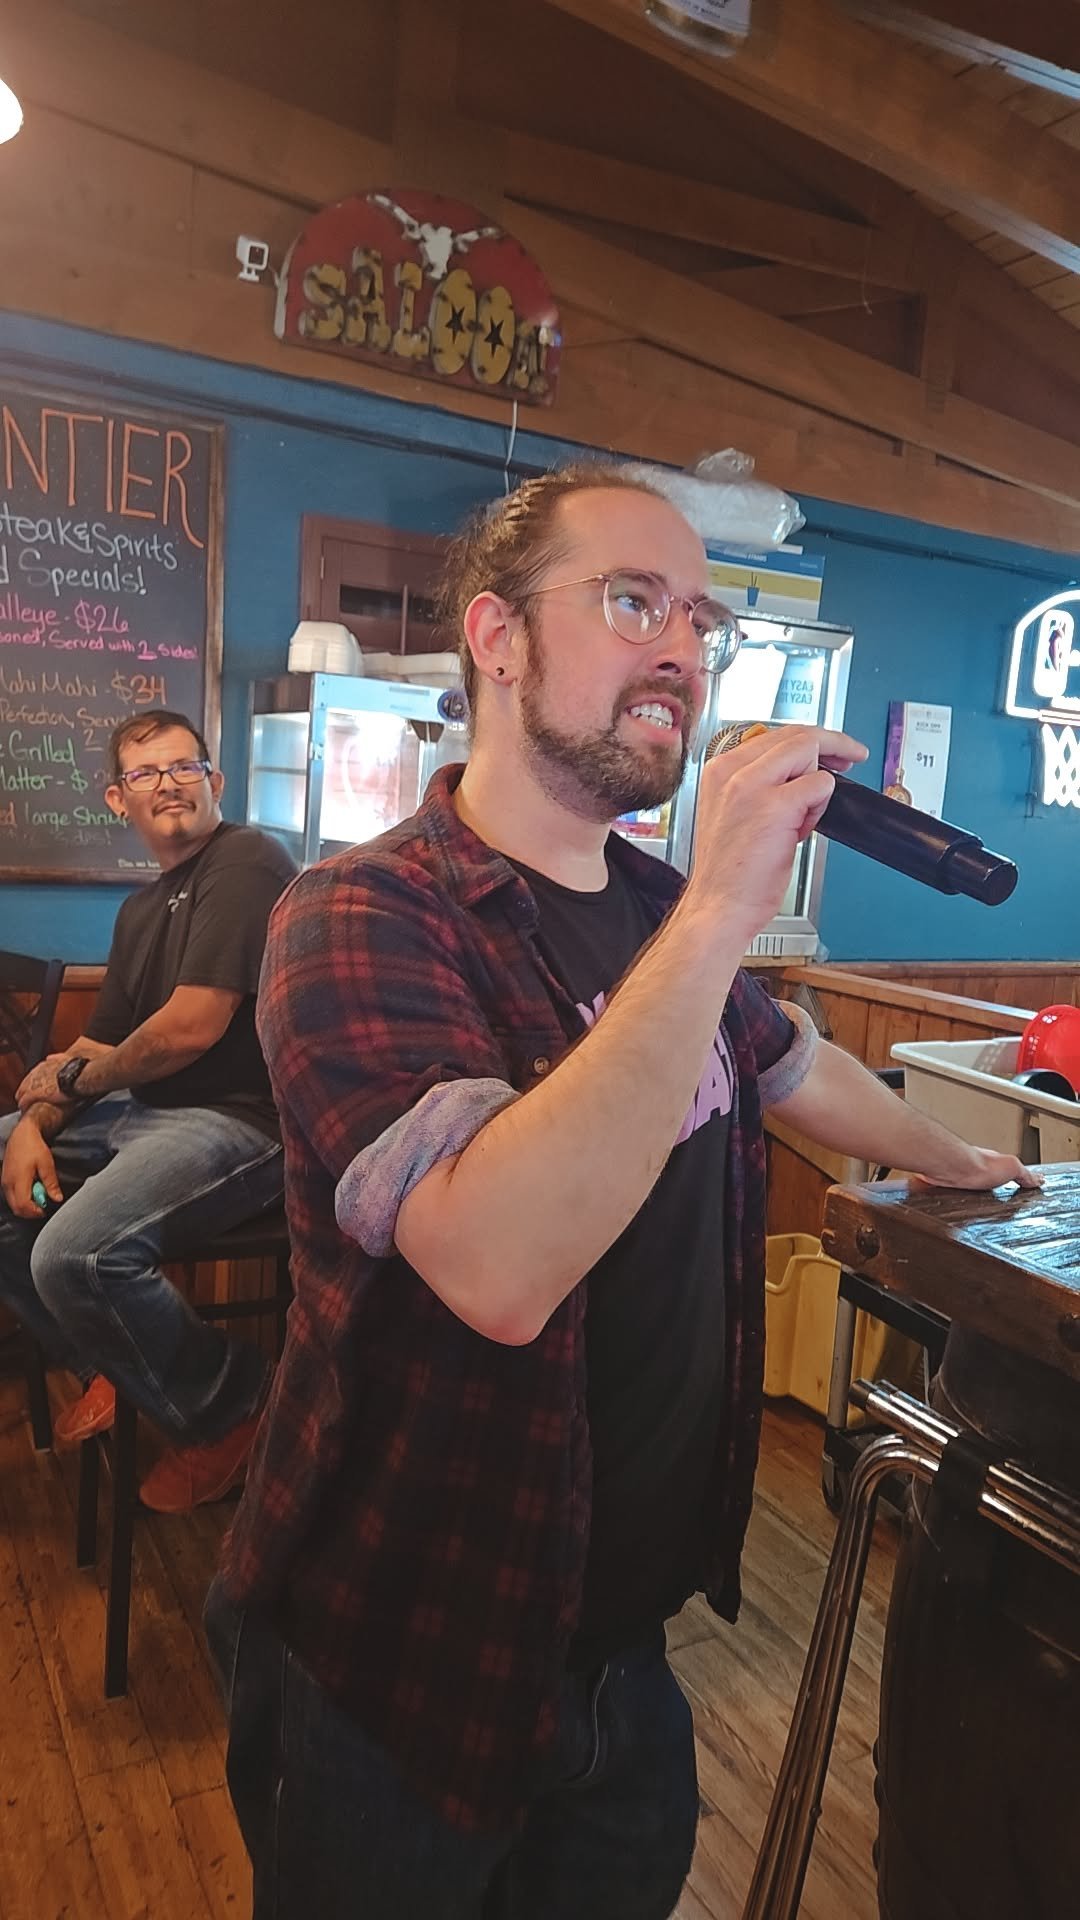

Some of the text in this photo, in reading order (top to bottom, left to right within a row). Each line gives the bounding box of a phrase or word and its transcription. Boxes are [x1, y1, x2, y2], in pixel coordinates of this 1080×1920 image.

[299, 246, 553, 394] SALOON
[2, 405, 205, 549] NTIER
[19, 547, 147, 597] Specials!
[111, 668, 167, 705] $34
[916, 752, 934, 768] $11
